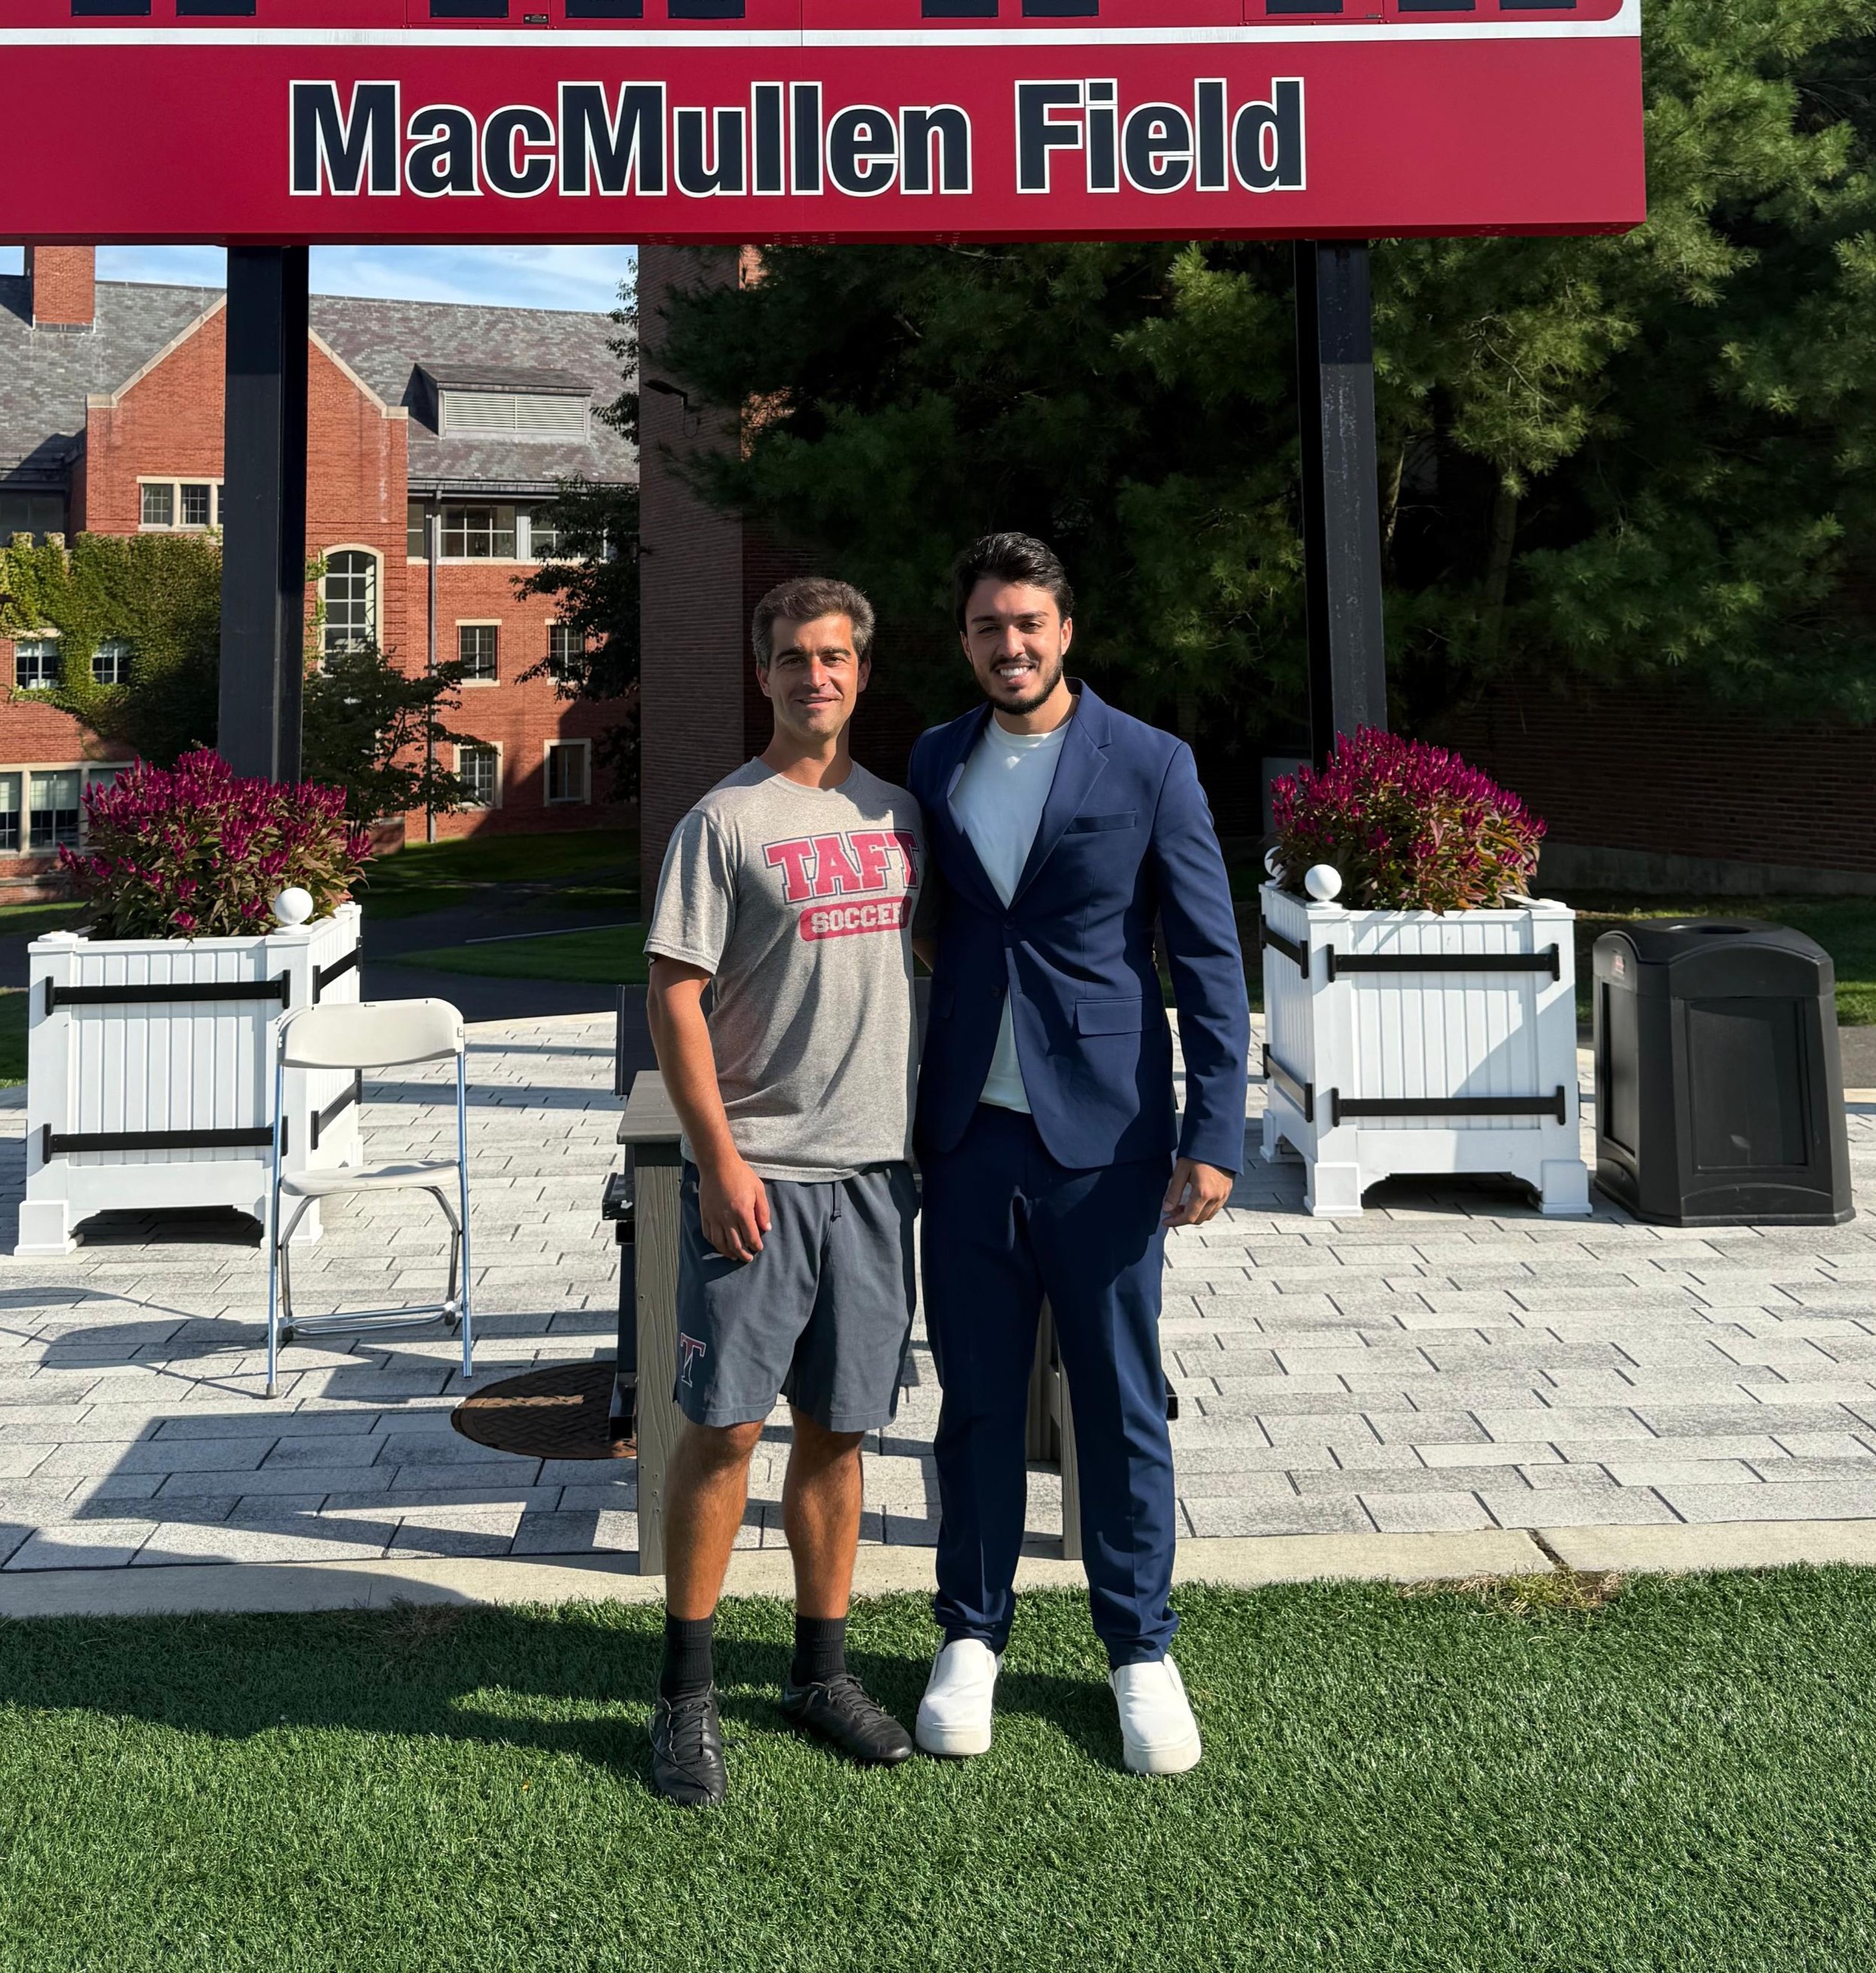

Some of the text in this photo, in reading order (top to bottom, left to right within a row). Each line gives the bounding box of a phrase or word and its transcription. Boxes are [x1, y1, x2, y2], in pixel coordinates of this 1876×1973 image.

[289, 76, 1307, 198] MacMullen Field
[761, 829, 919, 905] TAFT
[680, 1332, 706, 1388] T
